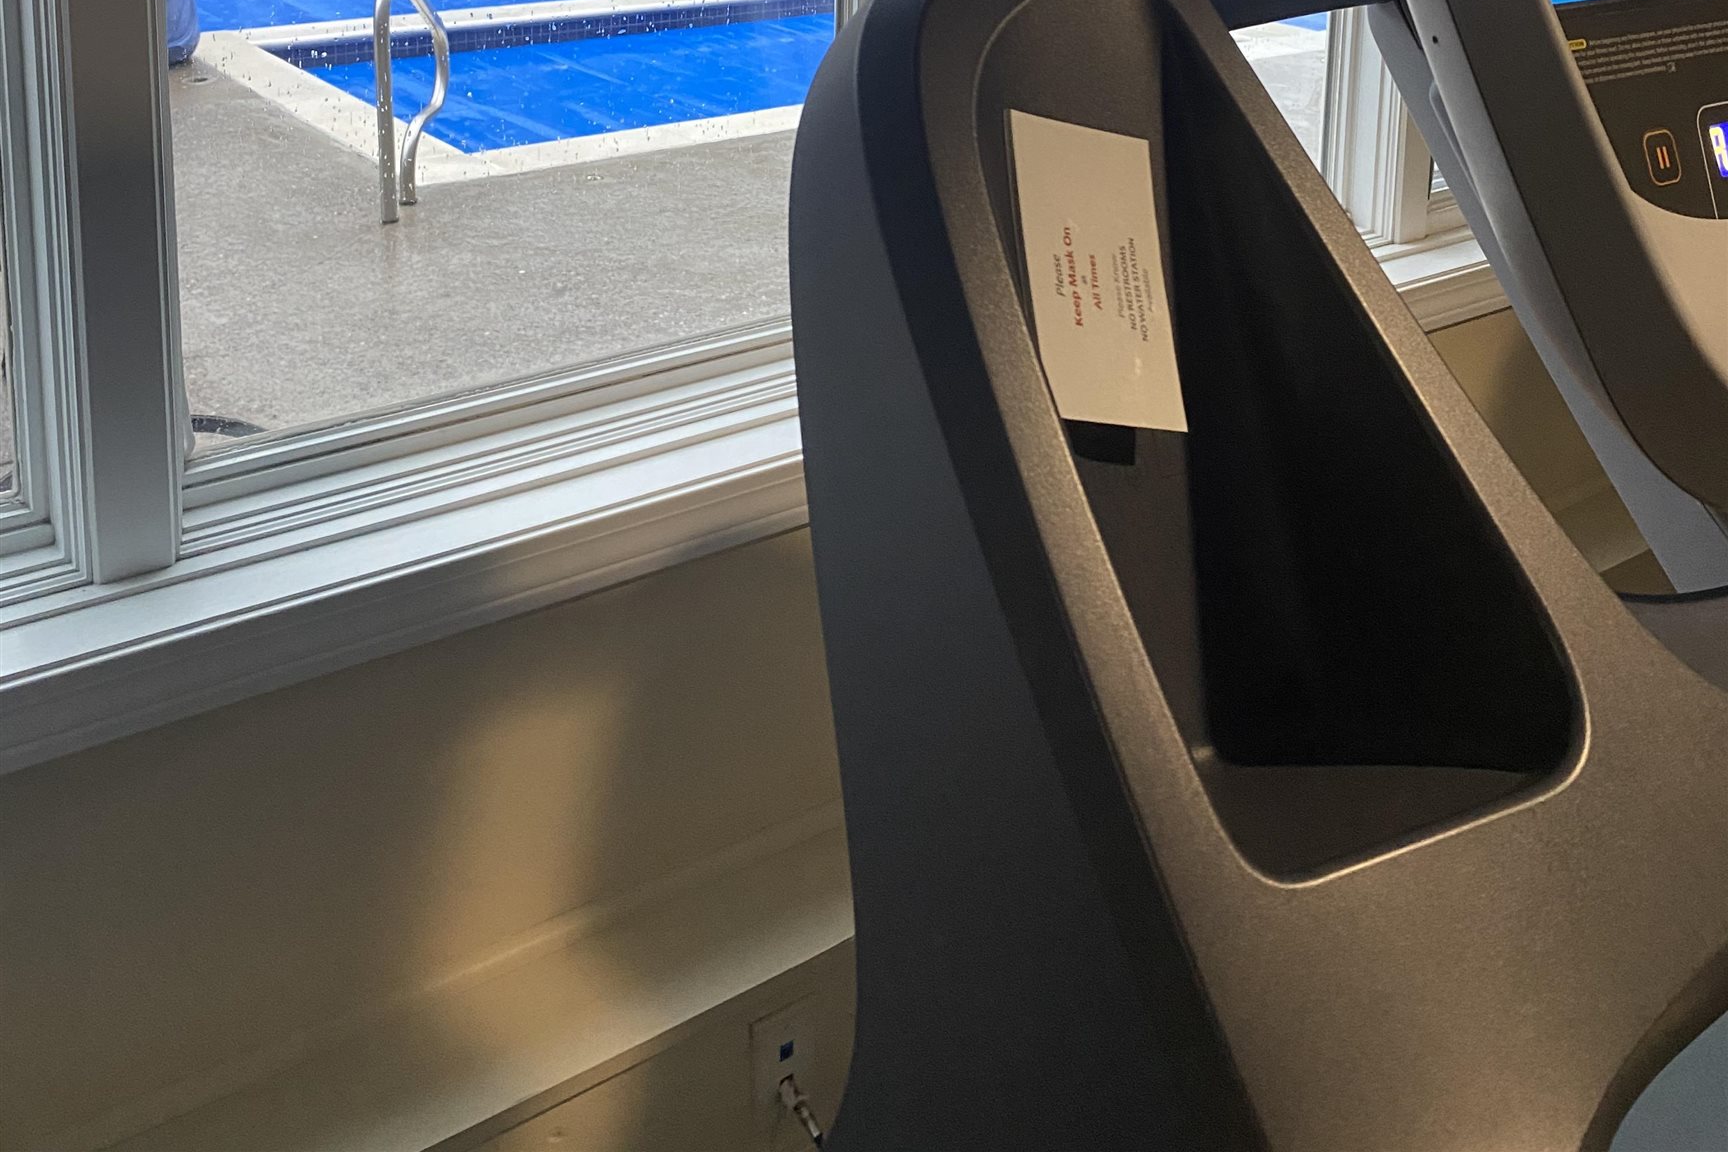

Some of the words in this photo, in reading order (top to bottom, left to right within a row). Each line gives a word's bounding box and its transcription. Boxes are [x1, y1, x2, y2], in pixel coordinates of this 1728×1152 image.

[1063, 227, 1072, 246] On
[1053, 254, 1066, 297] Please
[1064, 250, 1078, 287] Mask
[1088, 254, 1099, 289] Times
[1127, 237, 1140, 282] STATION
[1119, 245, 1135, 311] RESTROOMS
[1072, 291, 1084, 327] Keep
[1091, 292, 1103, 311] All
[1134, 285, 1146, 323] WATER
[1128, 313, 1137, 330] NO
[1140, 324, 1149, 342] NO
